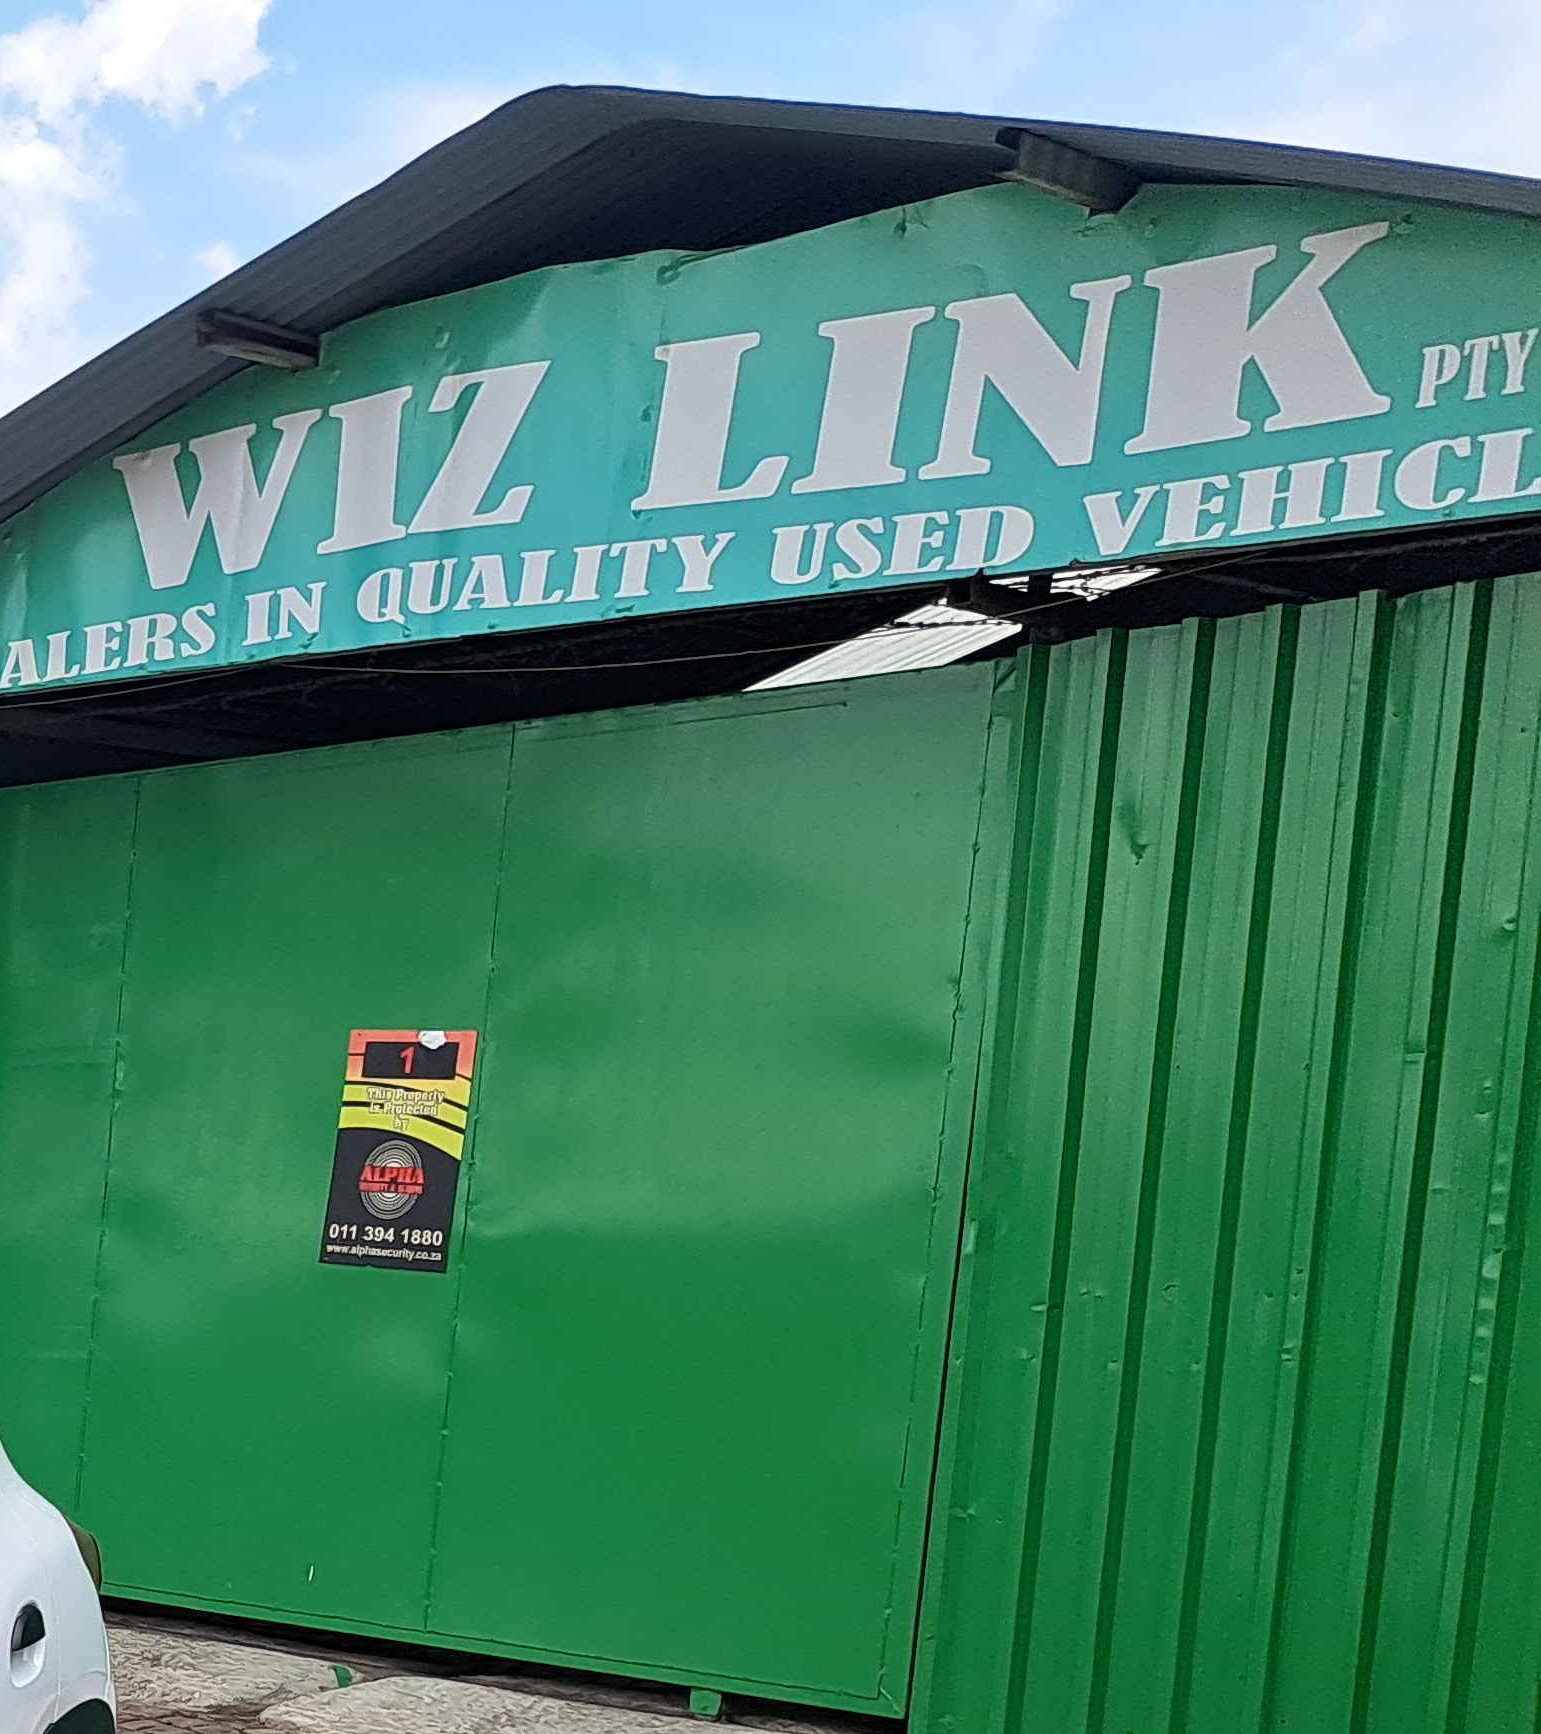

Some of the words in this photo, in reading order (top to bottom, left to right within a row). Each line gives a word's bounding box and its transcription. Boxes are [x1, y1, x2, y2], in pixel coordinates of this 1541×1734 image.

[114, 359, 552, 591] WIZ
[630, 221, 1393, 512] LINK
[1413, 329, 1540, 410] PTY
[242, 581, 327, 647] IN
[356, 530, 734, 628] QUALITY
[769, 505, 1035, 586] USED
[399, 1046, 415, 1074] 1
[360, 1164, 425, 1184] ALPHA
[329, 1223, 358, 1240] 011
[363, 1225, 395, 1243] 394
[400, 1228, 443, 1246] 1880
[326, 1243, 442, 1262] www.alphasecurity.co.za
